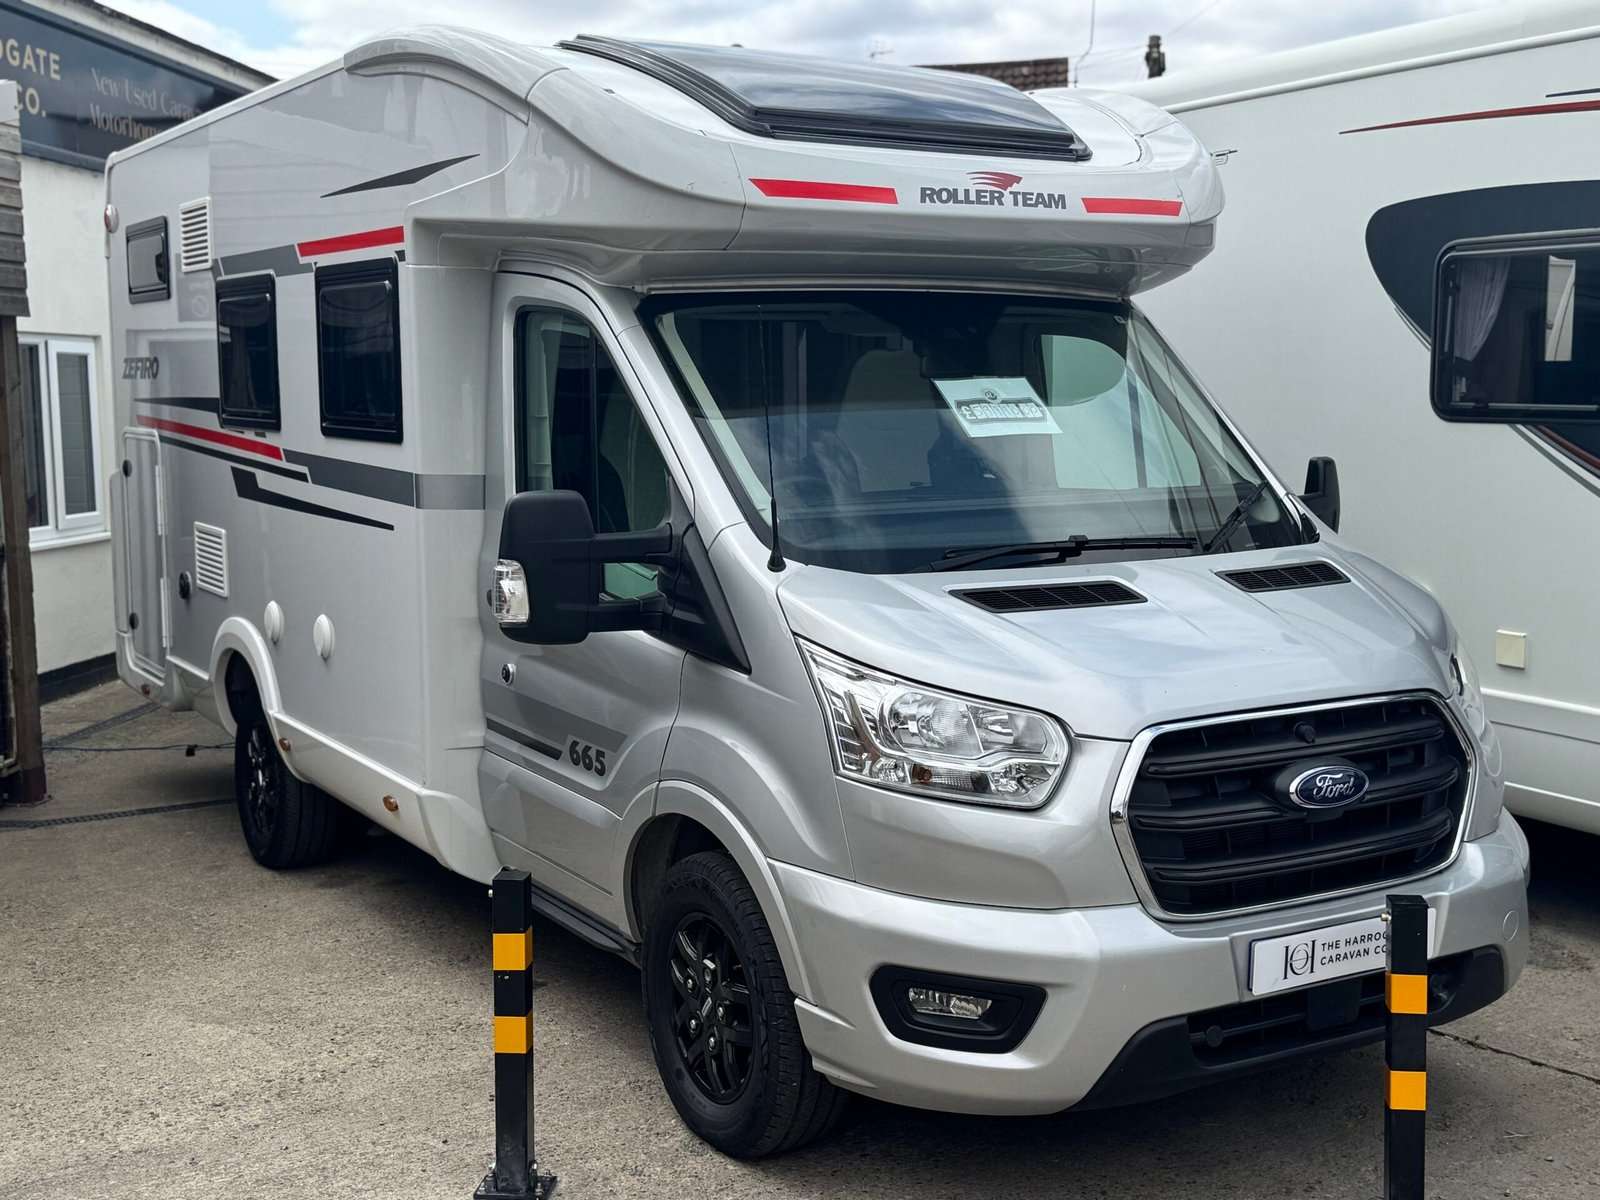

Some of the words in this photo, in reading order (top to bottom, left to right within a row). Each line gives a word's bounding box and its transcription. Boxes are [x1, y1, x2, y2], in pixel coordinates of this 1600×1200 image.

[0, 38, 61, 81] GATE
[920, 186, 1005, 206] ROLLER
[1009, 190, 1067, 210] TEAM
[121, 356, 160, 380] ZEFIRO
[569, 740, 606, 777] 665
[1312, 772, 1355, 800] Ford
[1319, 947, 1370, 966] CARAVAN
[1321, 939, 1341, 952] THE
